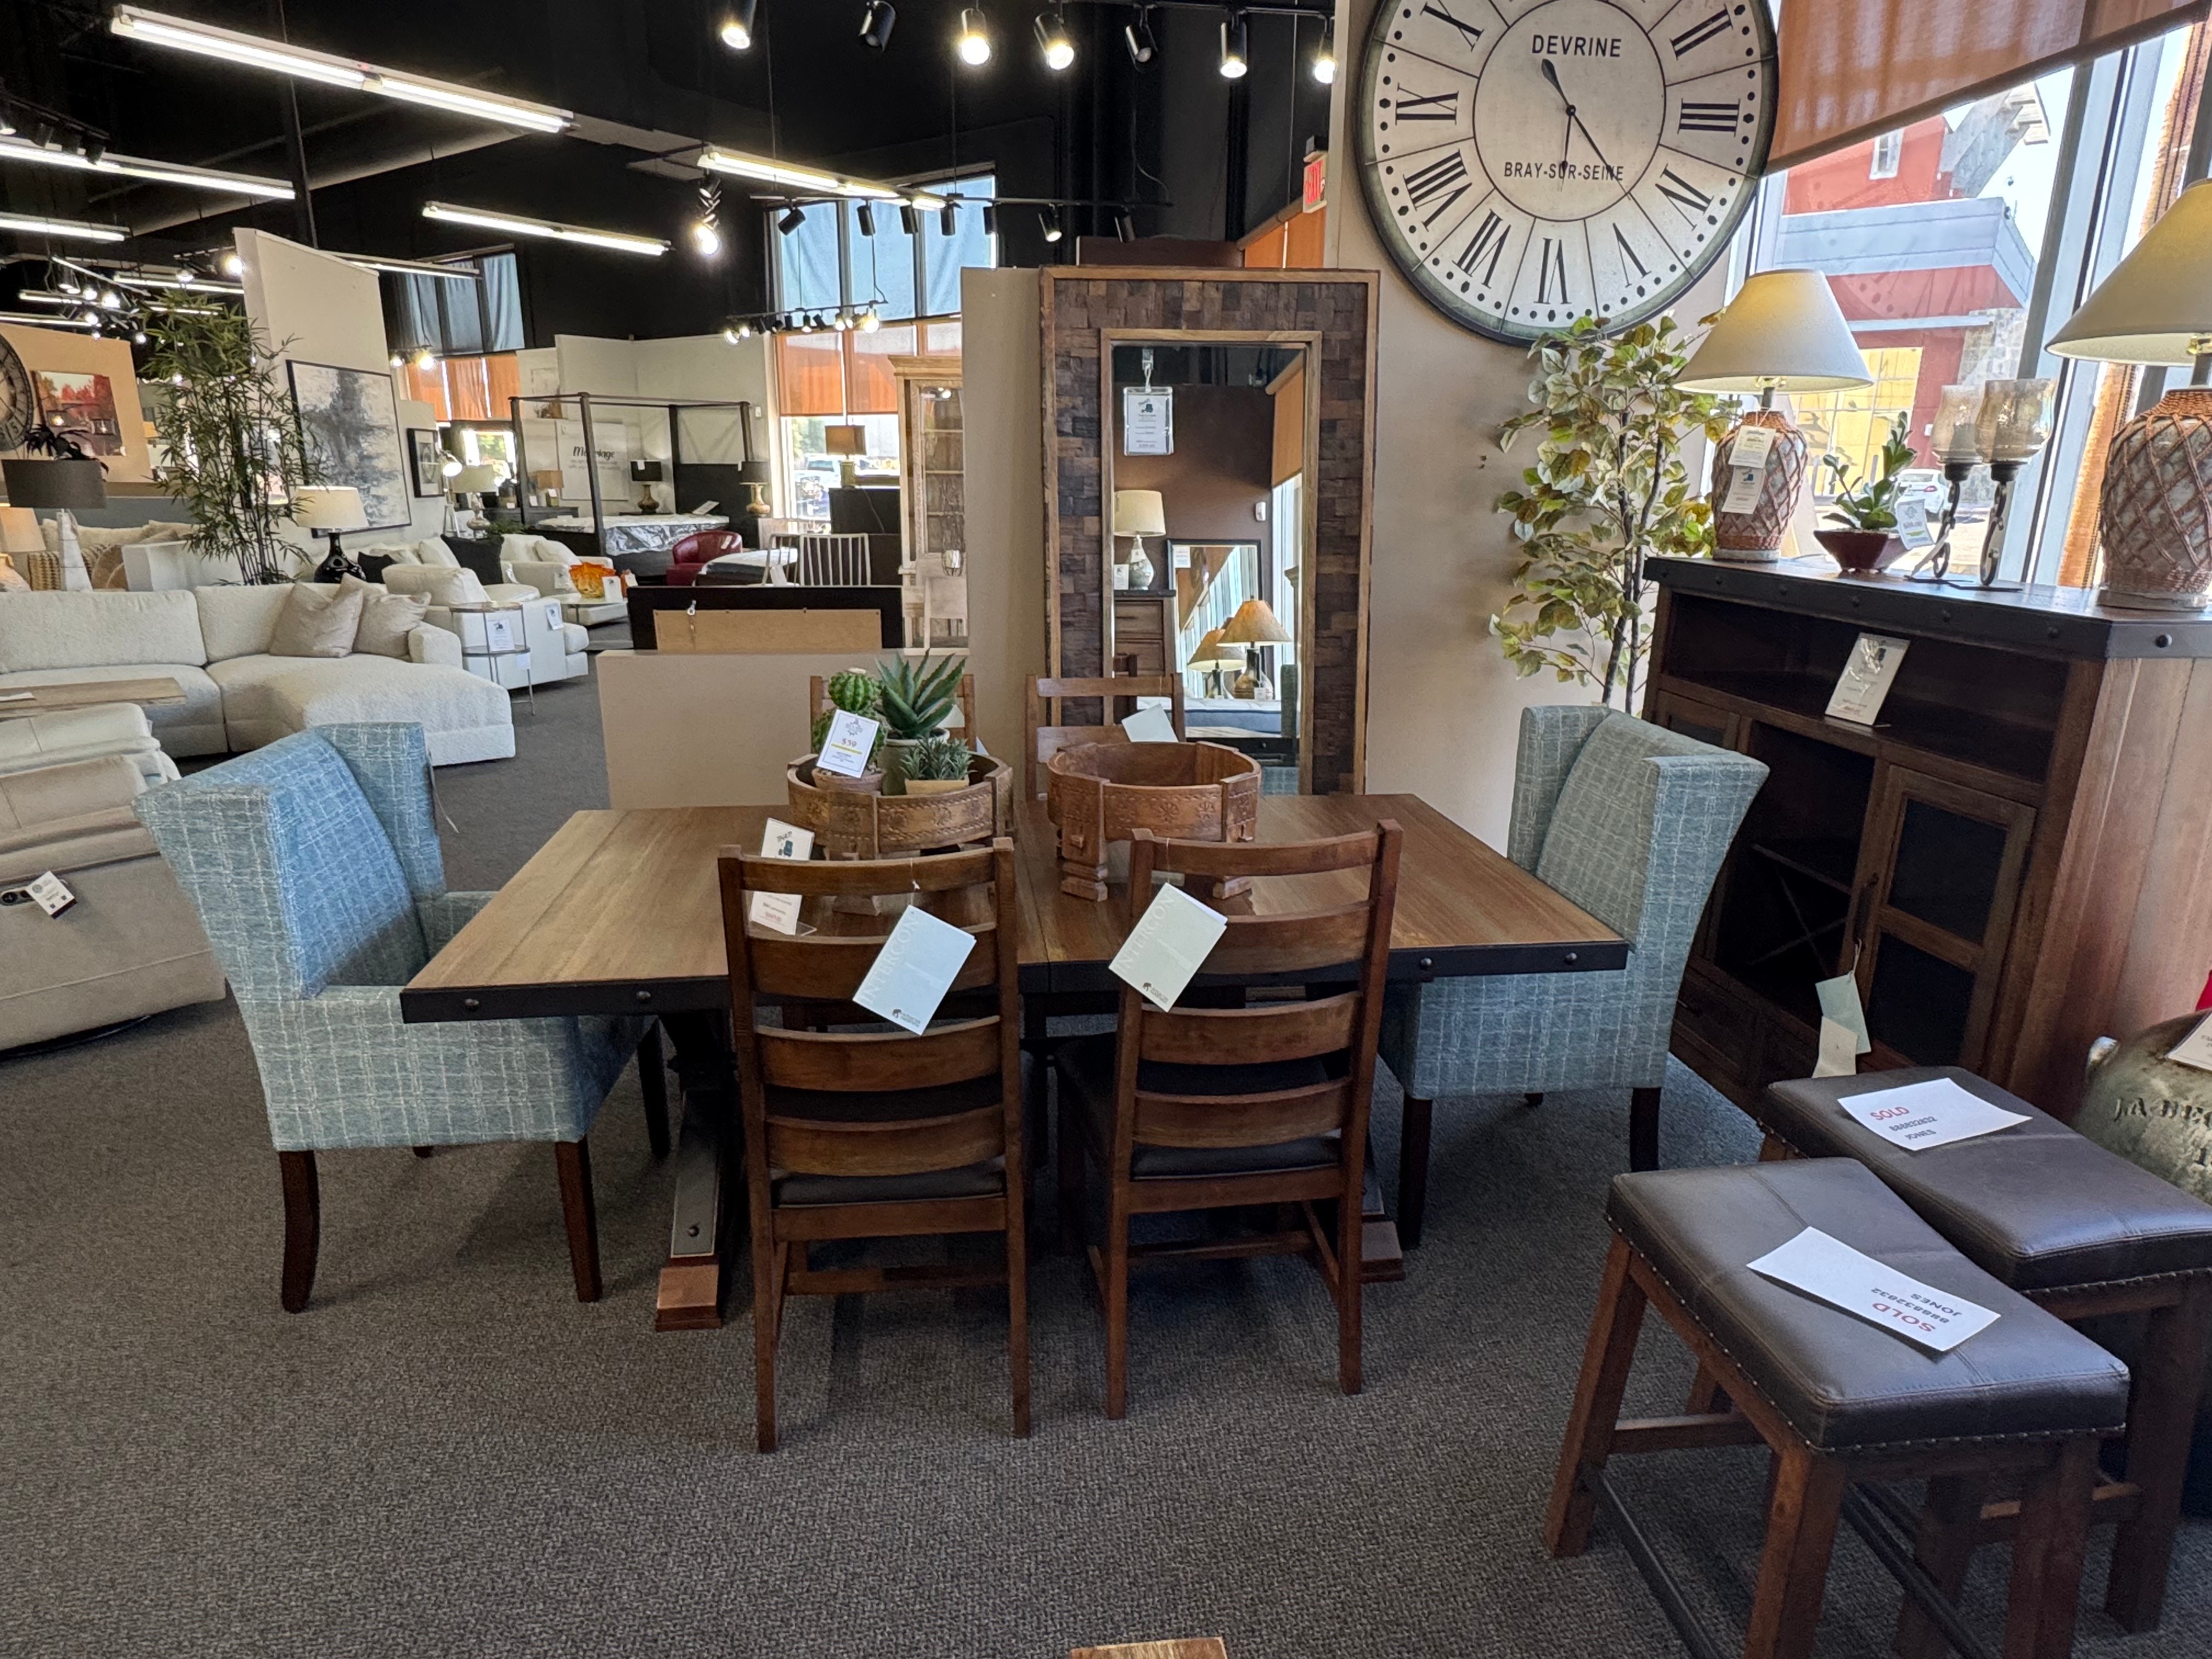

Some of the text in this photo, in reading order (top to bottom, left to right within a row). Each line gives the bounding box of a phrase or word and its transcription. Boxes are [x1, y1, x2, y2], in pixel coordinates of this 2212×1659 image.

[1532, 34, 1622, 57] DEVRINE
[1669, 3, 1733, 61] II
[1395, 82, 1459, 126] IX
[1677, 98, 1741, 137] III
[1403, 149, 1472, 232] VIII
[1504, 162, 1624, 181] BRAY-SUR-SEINE
[1655, 163, 1714, 232] IV
[1452, 208, 1511, 289] VII
[1533, 238, 1572, 304] VI
[1613, 223, 1652, 287] V
[1115, 893, 1176, 975] INTERCON
[859, 915, 920, 1005] INTERCON
[1870, 1107, 1910, 1120] SOLD
[1904, 1129, 1937, 1140] JONES
[1872, 1303, 1936, 1331] SOLD
[1910, 1294, 1962, 1316] JONES
